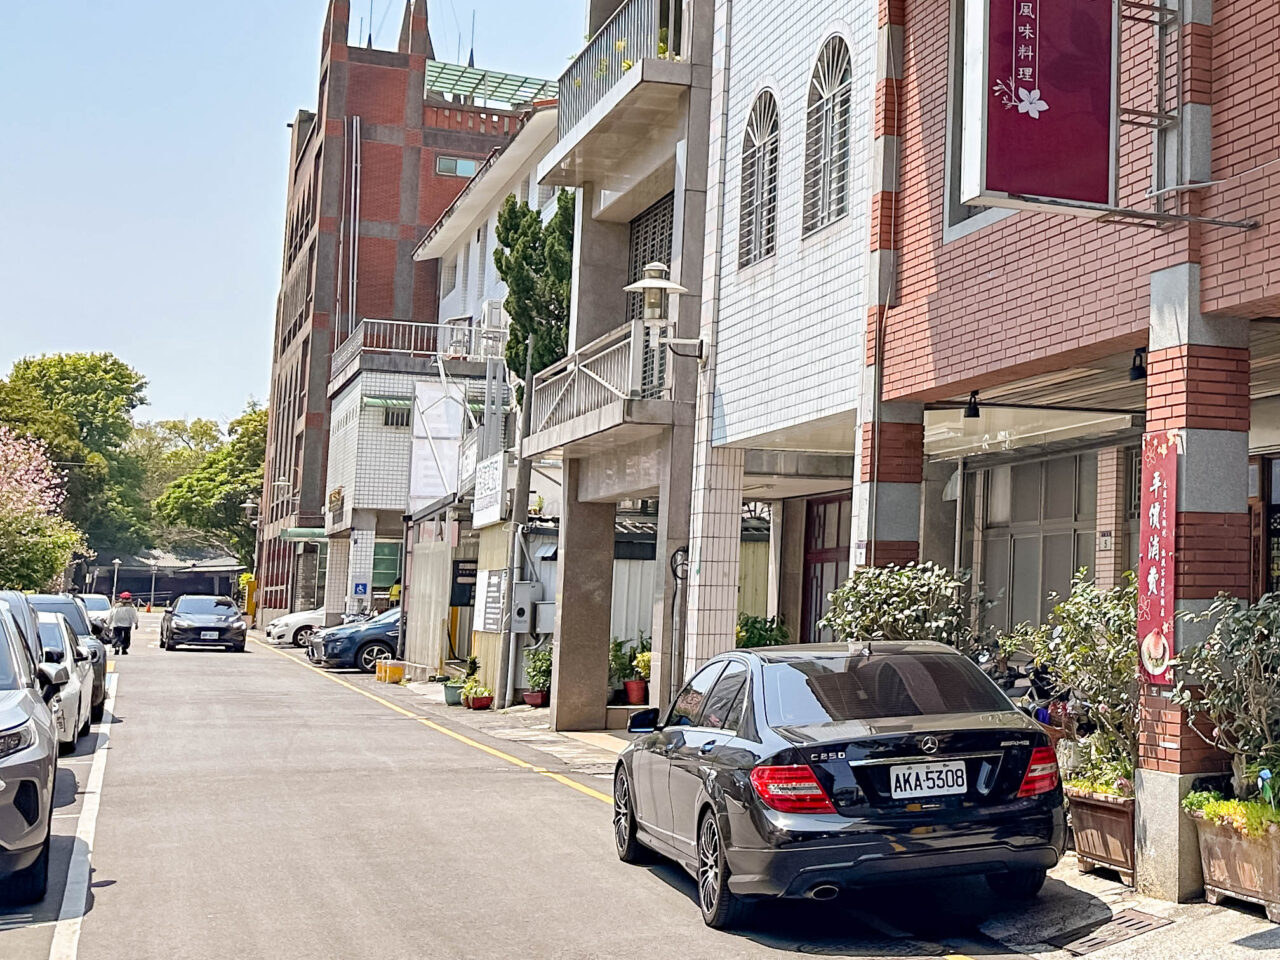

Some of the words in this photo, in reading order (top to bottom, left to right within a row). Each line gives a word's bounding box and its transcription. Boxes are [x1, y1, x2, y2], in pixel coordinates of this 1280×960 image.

[1147, 471, 1162, 596] 平價消費
[894, 768, 965, 792] AKA-5308
